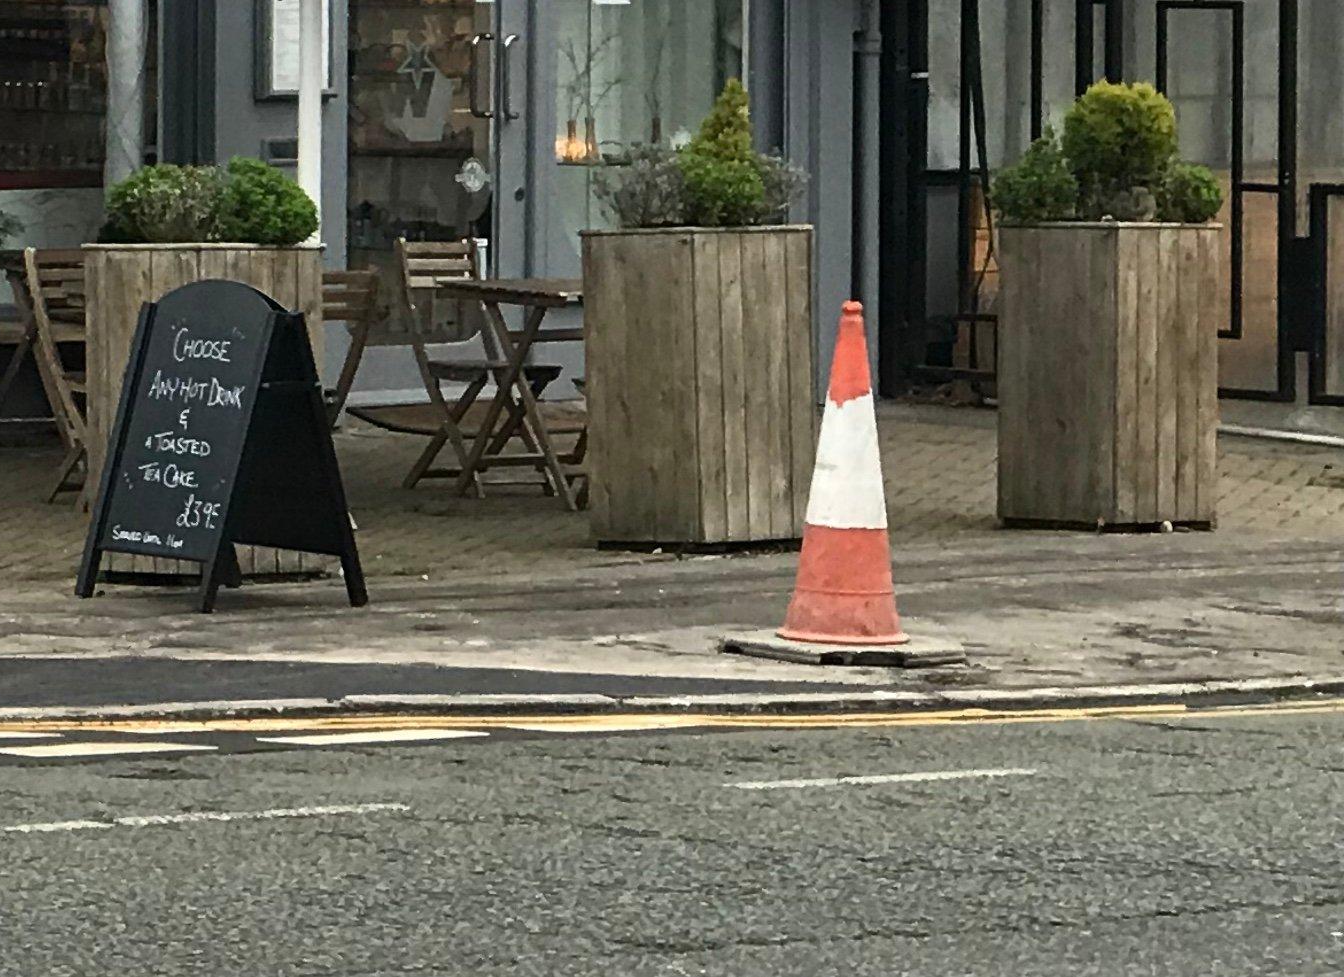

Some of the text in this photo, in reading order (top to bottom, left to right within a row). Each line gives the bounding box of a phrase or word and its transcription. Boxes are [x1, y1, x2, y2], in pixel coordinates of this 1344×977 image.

[173, 327, 232, 362] CHOOSE
[148, 369, 246, 410] ANY HOT DRINK
[154, 430, 211, 457] TOASTED
[137, 461, 199, 488] TEA CAKE
